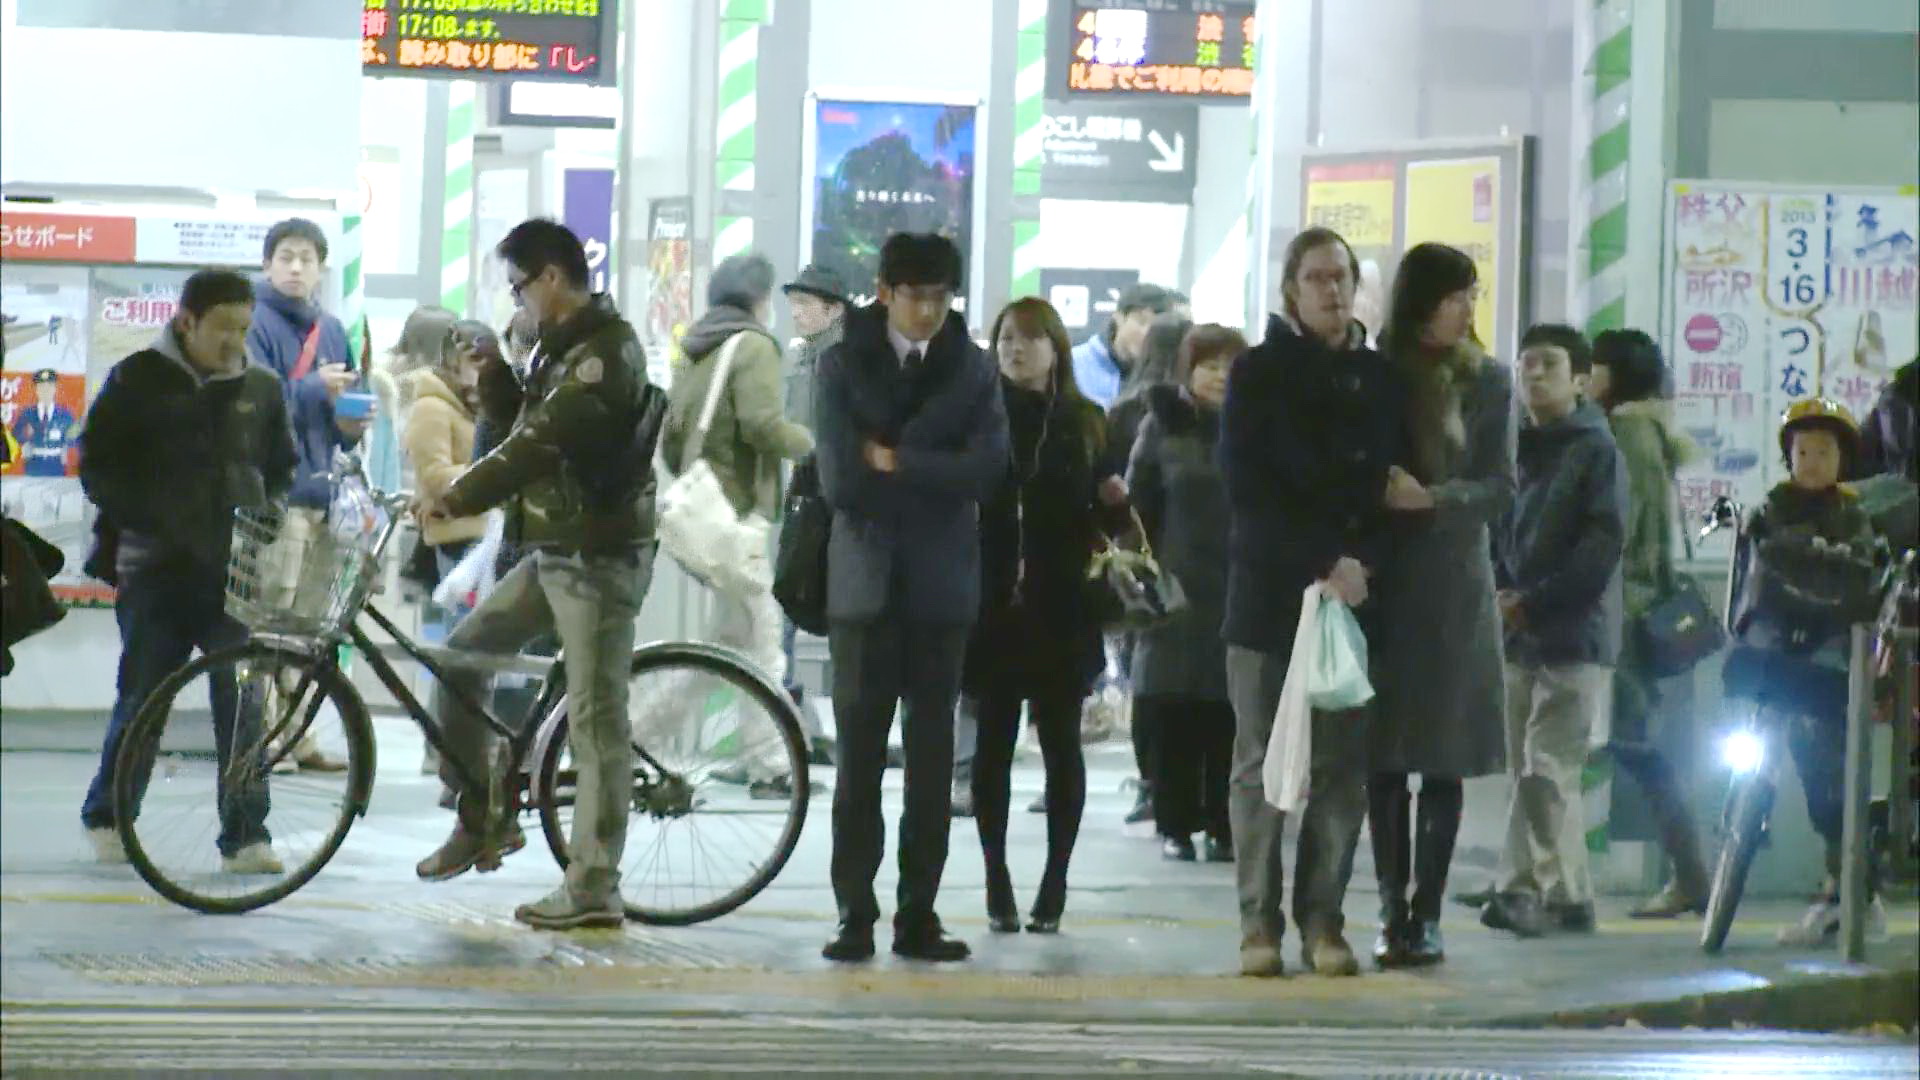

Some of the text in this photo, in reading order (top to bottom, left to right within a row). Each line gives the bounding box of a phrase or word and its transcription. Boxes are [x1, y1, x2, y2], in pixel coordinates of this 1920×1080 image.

[399, 14, 457, 37] 17:08
[1781, 210, 1816, 224] 2013
[1786, 228, 1808, 258] 3
[1686, 270, 1752, 303] 所沢
[1781, 274, 1815, 304] 16
[1840, 266, 1915, 304] 川越
[1779, 327, 1810, 416] つな
